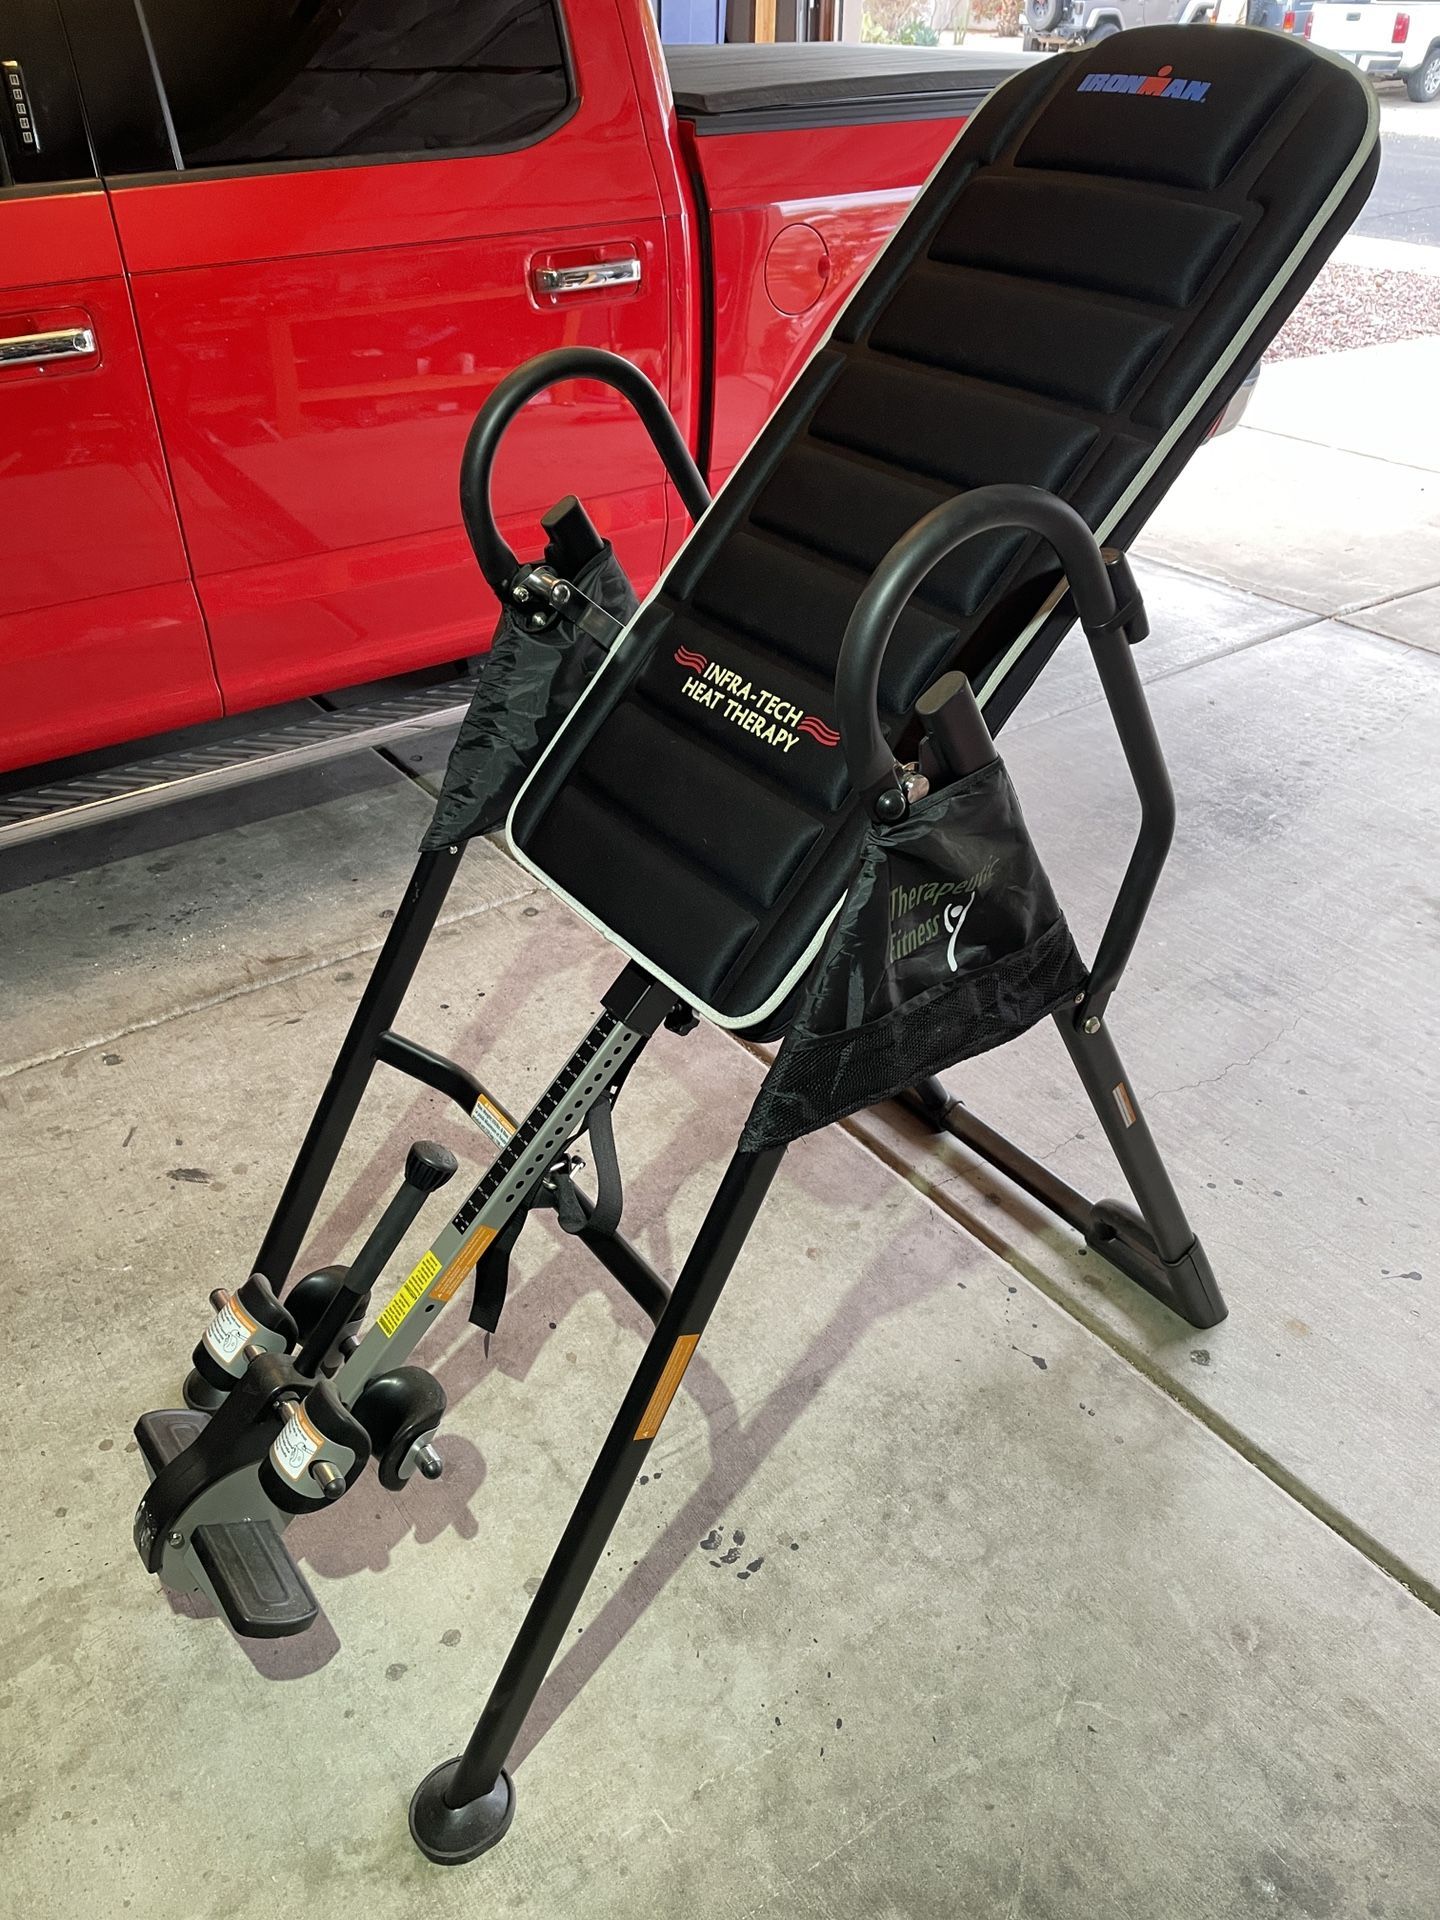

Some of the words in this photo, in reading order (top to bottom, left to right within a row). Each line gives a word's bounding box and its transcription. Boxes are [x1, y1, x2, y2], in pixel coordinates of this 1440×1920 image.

[1077, 64, 1212, 102] IRONMAN
[681, 676, 725, 710] HEAT
[723, 699, 800, 753] THERAPY
[702, 662, 804, 728] INFRA-TECH
[890, 854, 1000, 921] Therapeutic
